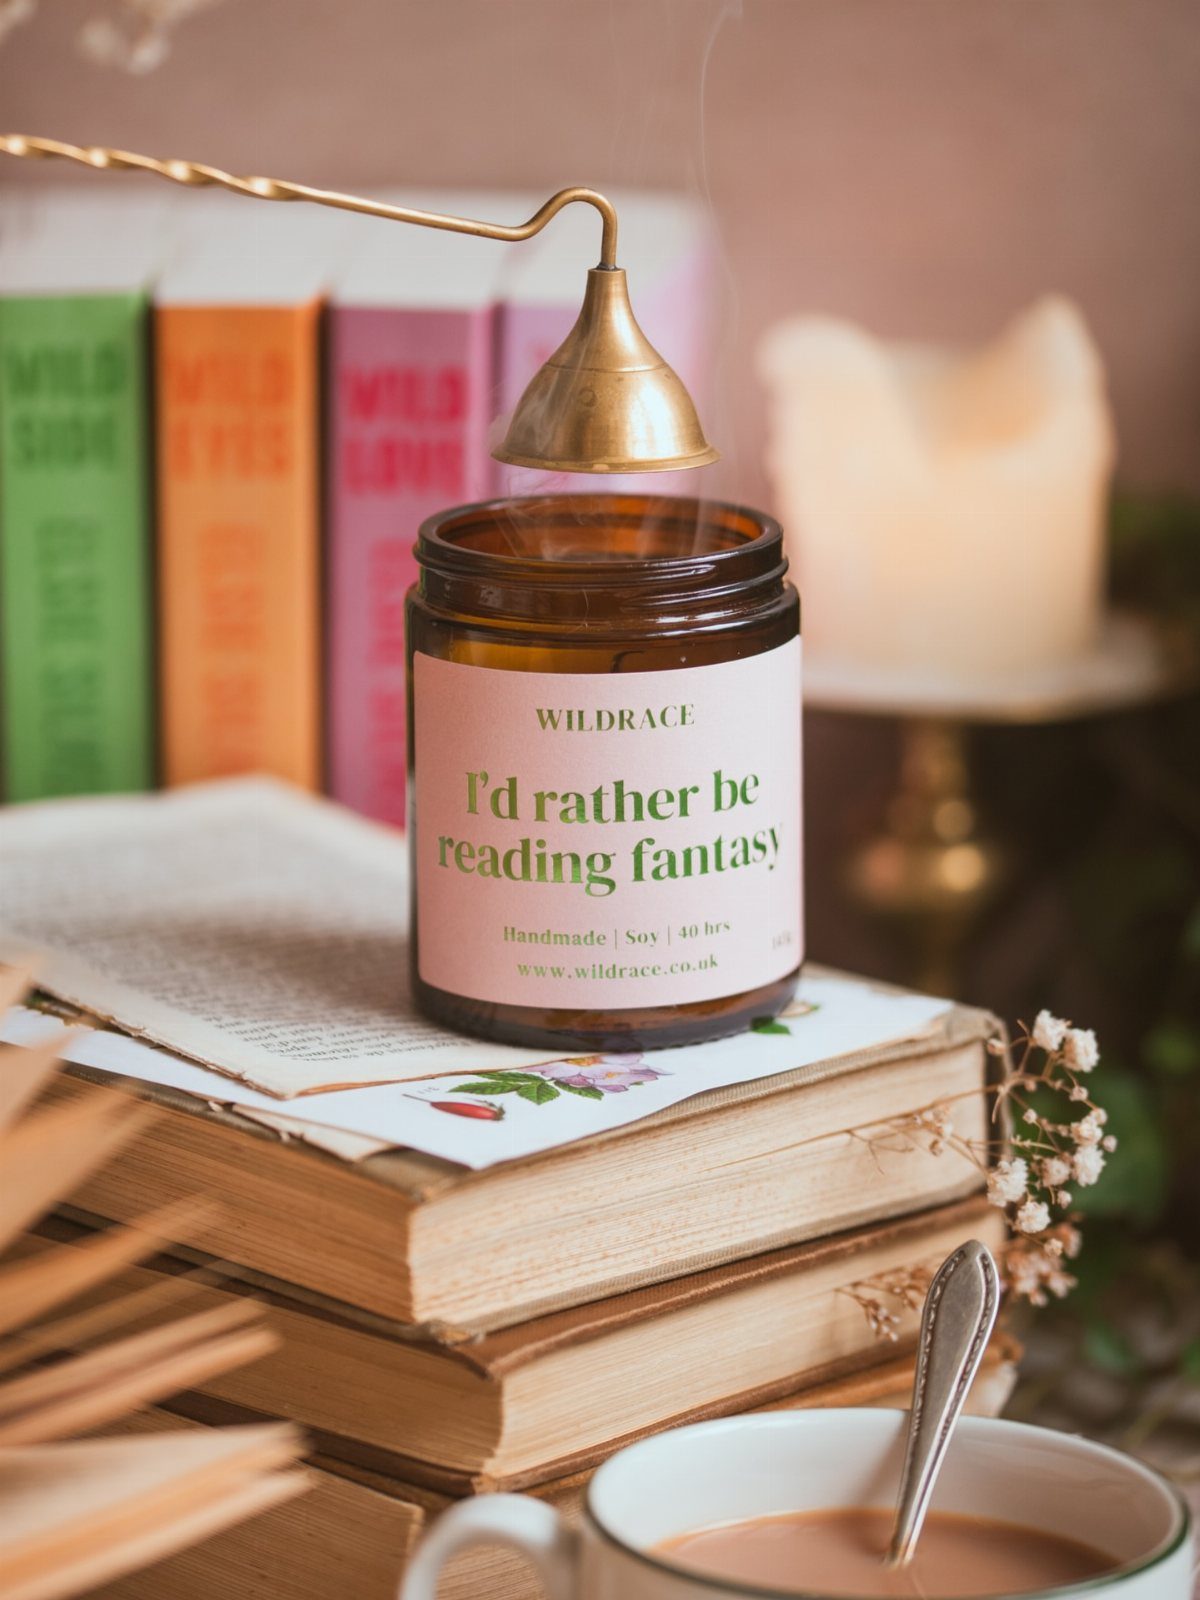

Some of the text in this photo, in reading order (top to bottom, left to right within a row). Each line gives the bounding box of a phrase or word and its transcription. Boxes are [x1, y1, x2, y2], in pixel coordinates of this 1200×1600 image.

[536, 703, 696, 732] WILDRACE
[534, 780, 701, 825] rather
[712, 769, 761, 813] be
[437, 823, 783, 898] reading fantasy
[503, 920, 731, 948] Handmade Soy 40 hrs
[517, 954, 719, 981] www.wildrace.co.uk
